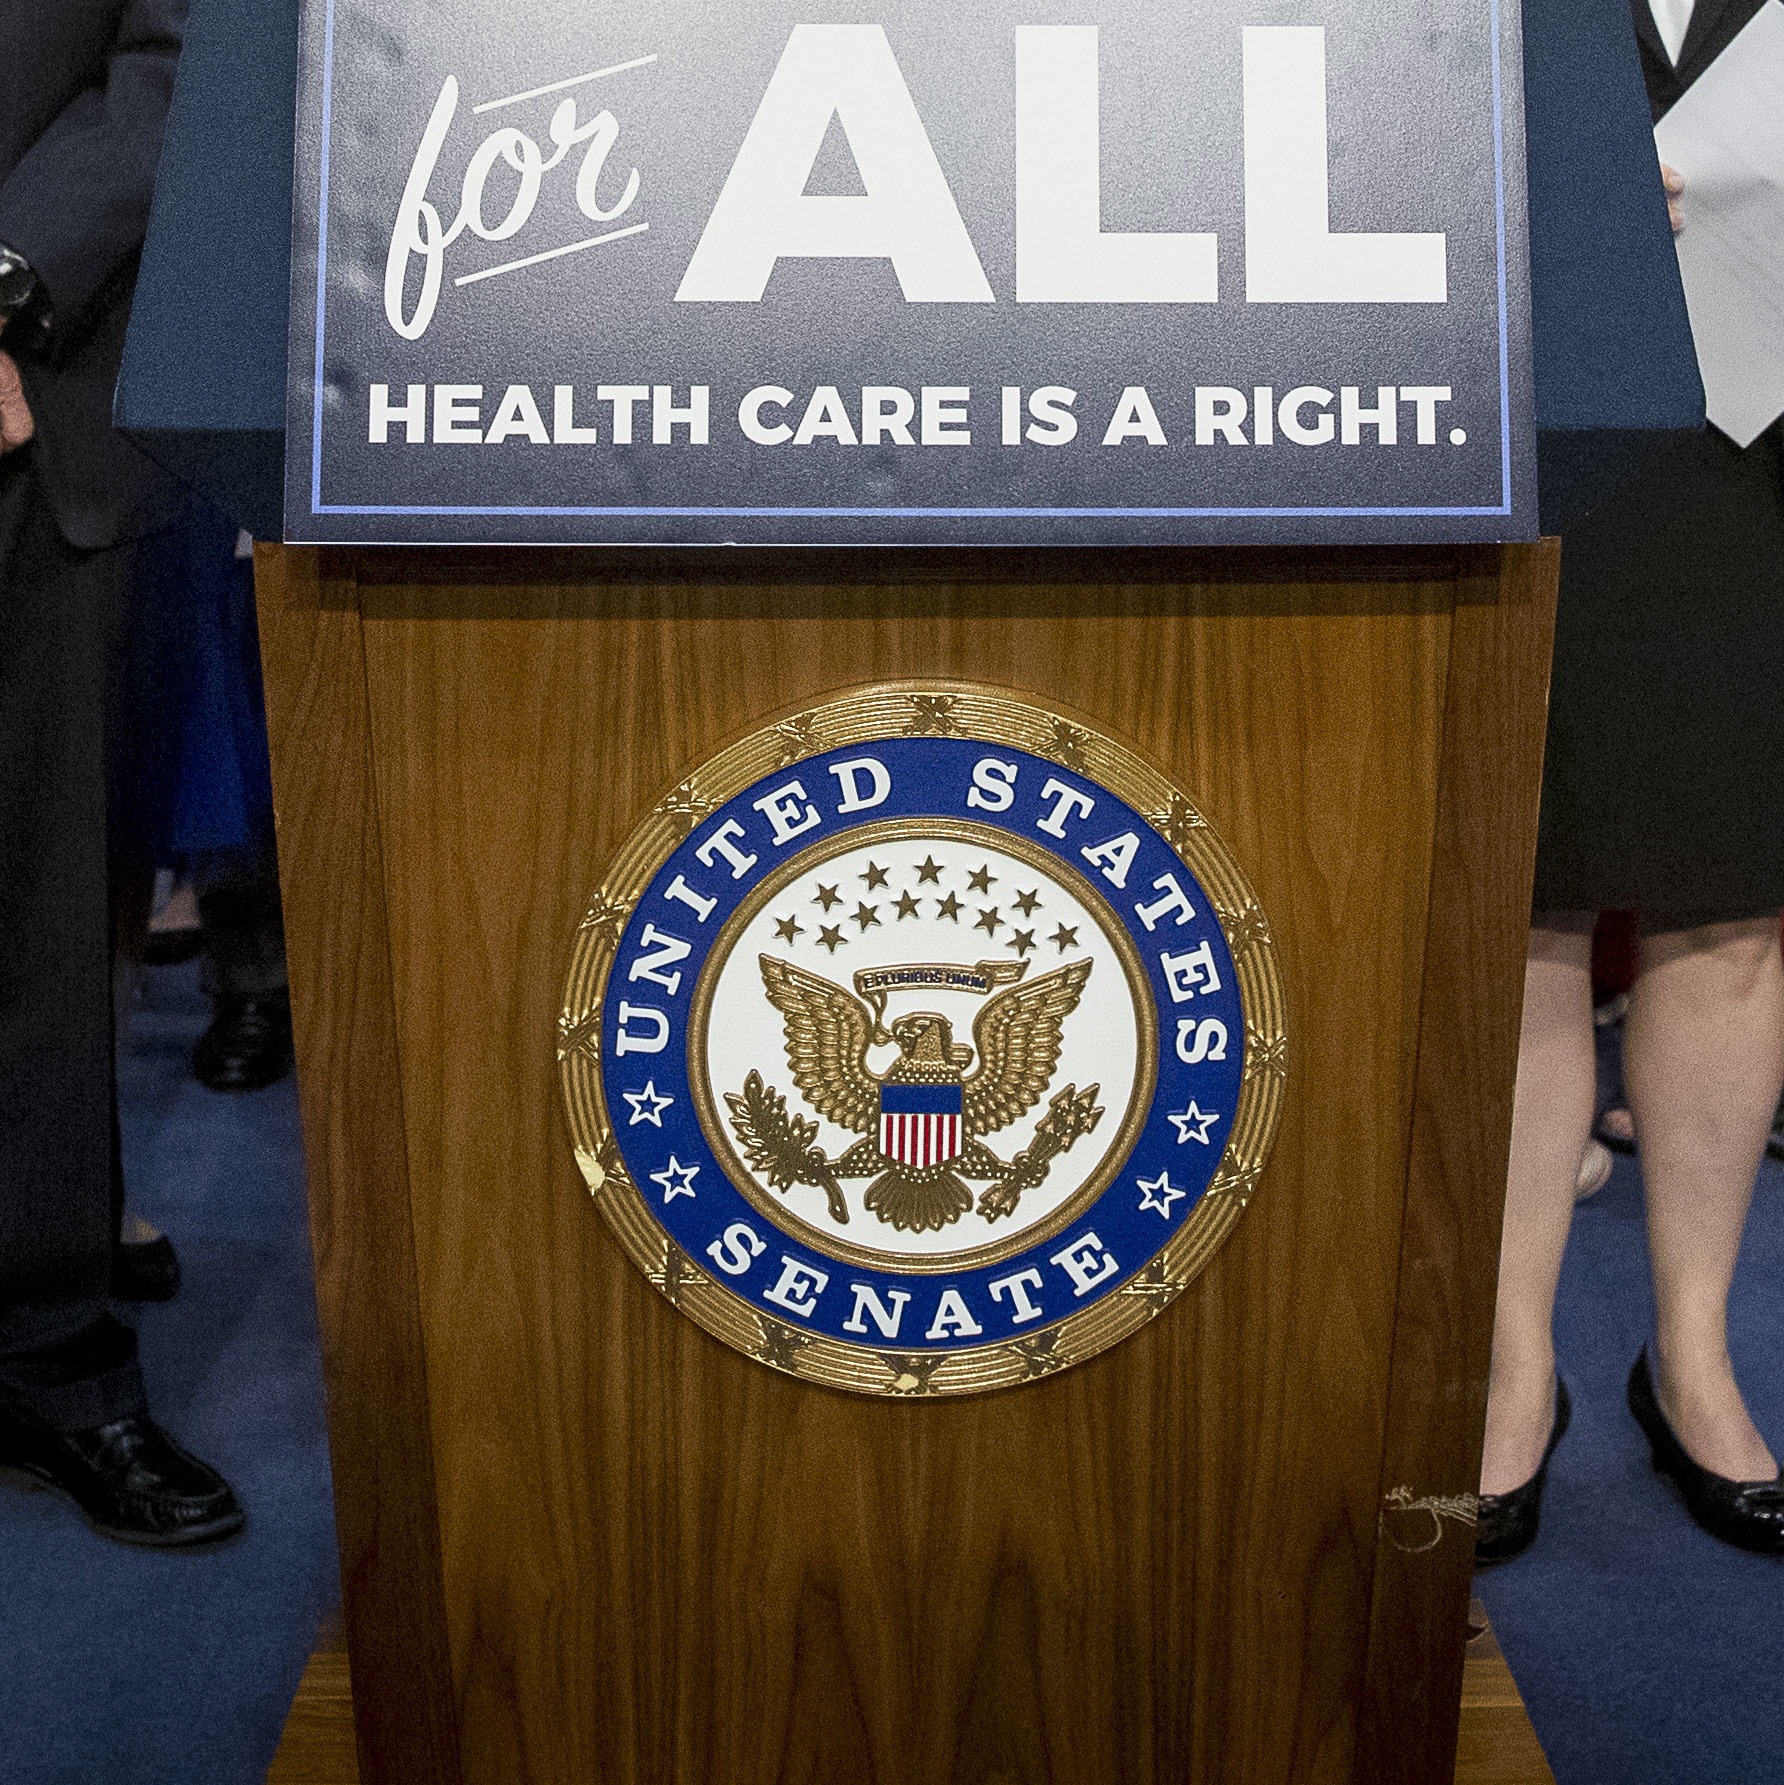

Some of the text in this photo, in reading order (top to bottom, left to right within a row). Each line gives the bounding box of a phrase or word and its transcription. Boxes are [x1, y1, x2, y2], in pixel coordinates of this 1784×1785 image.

[385, 23, 1447, 340] for ALL
[368, 384, 1467, 447] HEALTH CARE IS A RIGHT.
[616, 757, 1228, 1064] UNITED STATES
[706, 1222, 1121, 1341] SENATE
